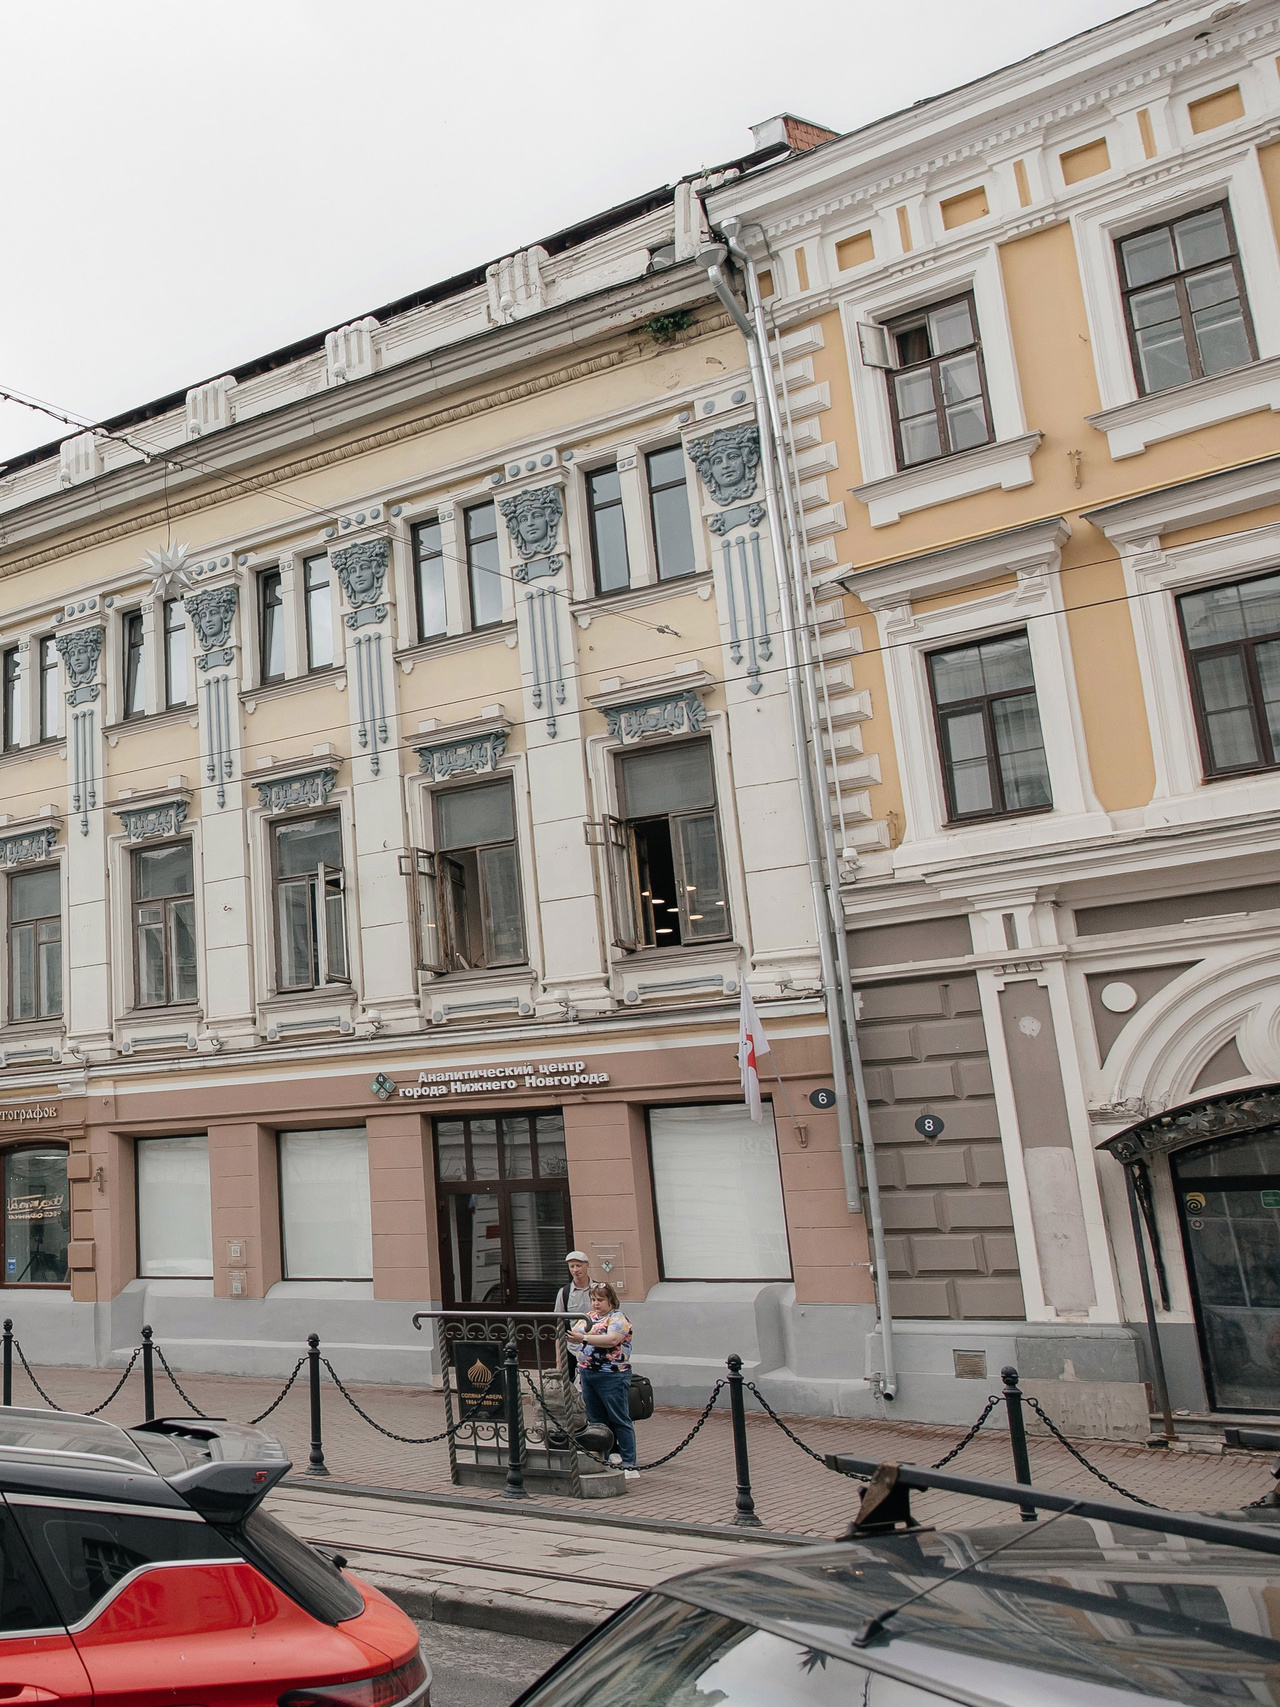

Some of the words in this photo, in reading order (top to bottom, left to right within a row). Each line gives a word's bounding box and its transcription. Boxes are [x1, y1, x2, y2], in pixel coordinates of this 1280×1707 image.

[418, 1062, 534, 1083] Аналитический
[538, 1061, 586, 1075] центр
[399, 1085, 448, 1099] города
[450, 1079, 518, 1093] Нижнего
[524, 1072, 610, 1087] Новгорода
[818, 1092, 827, 1104] 6
[924, 1118, 934, 1131] 8
[252, 1470, 269, 1483] S
